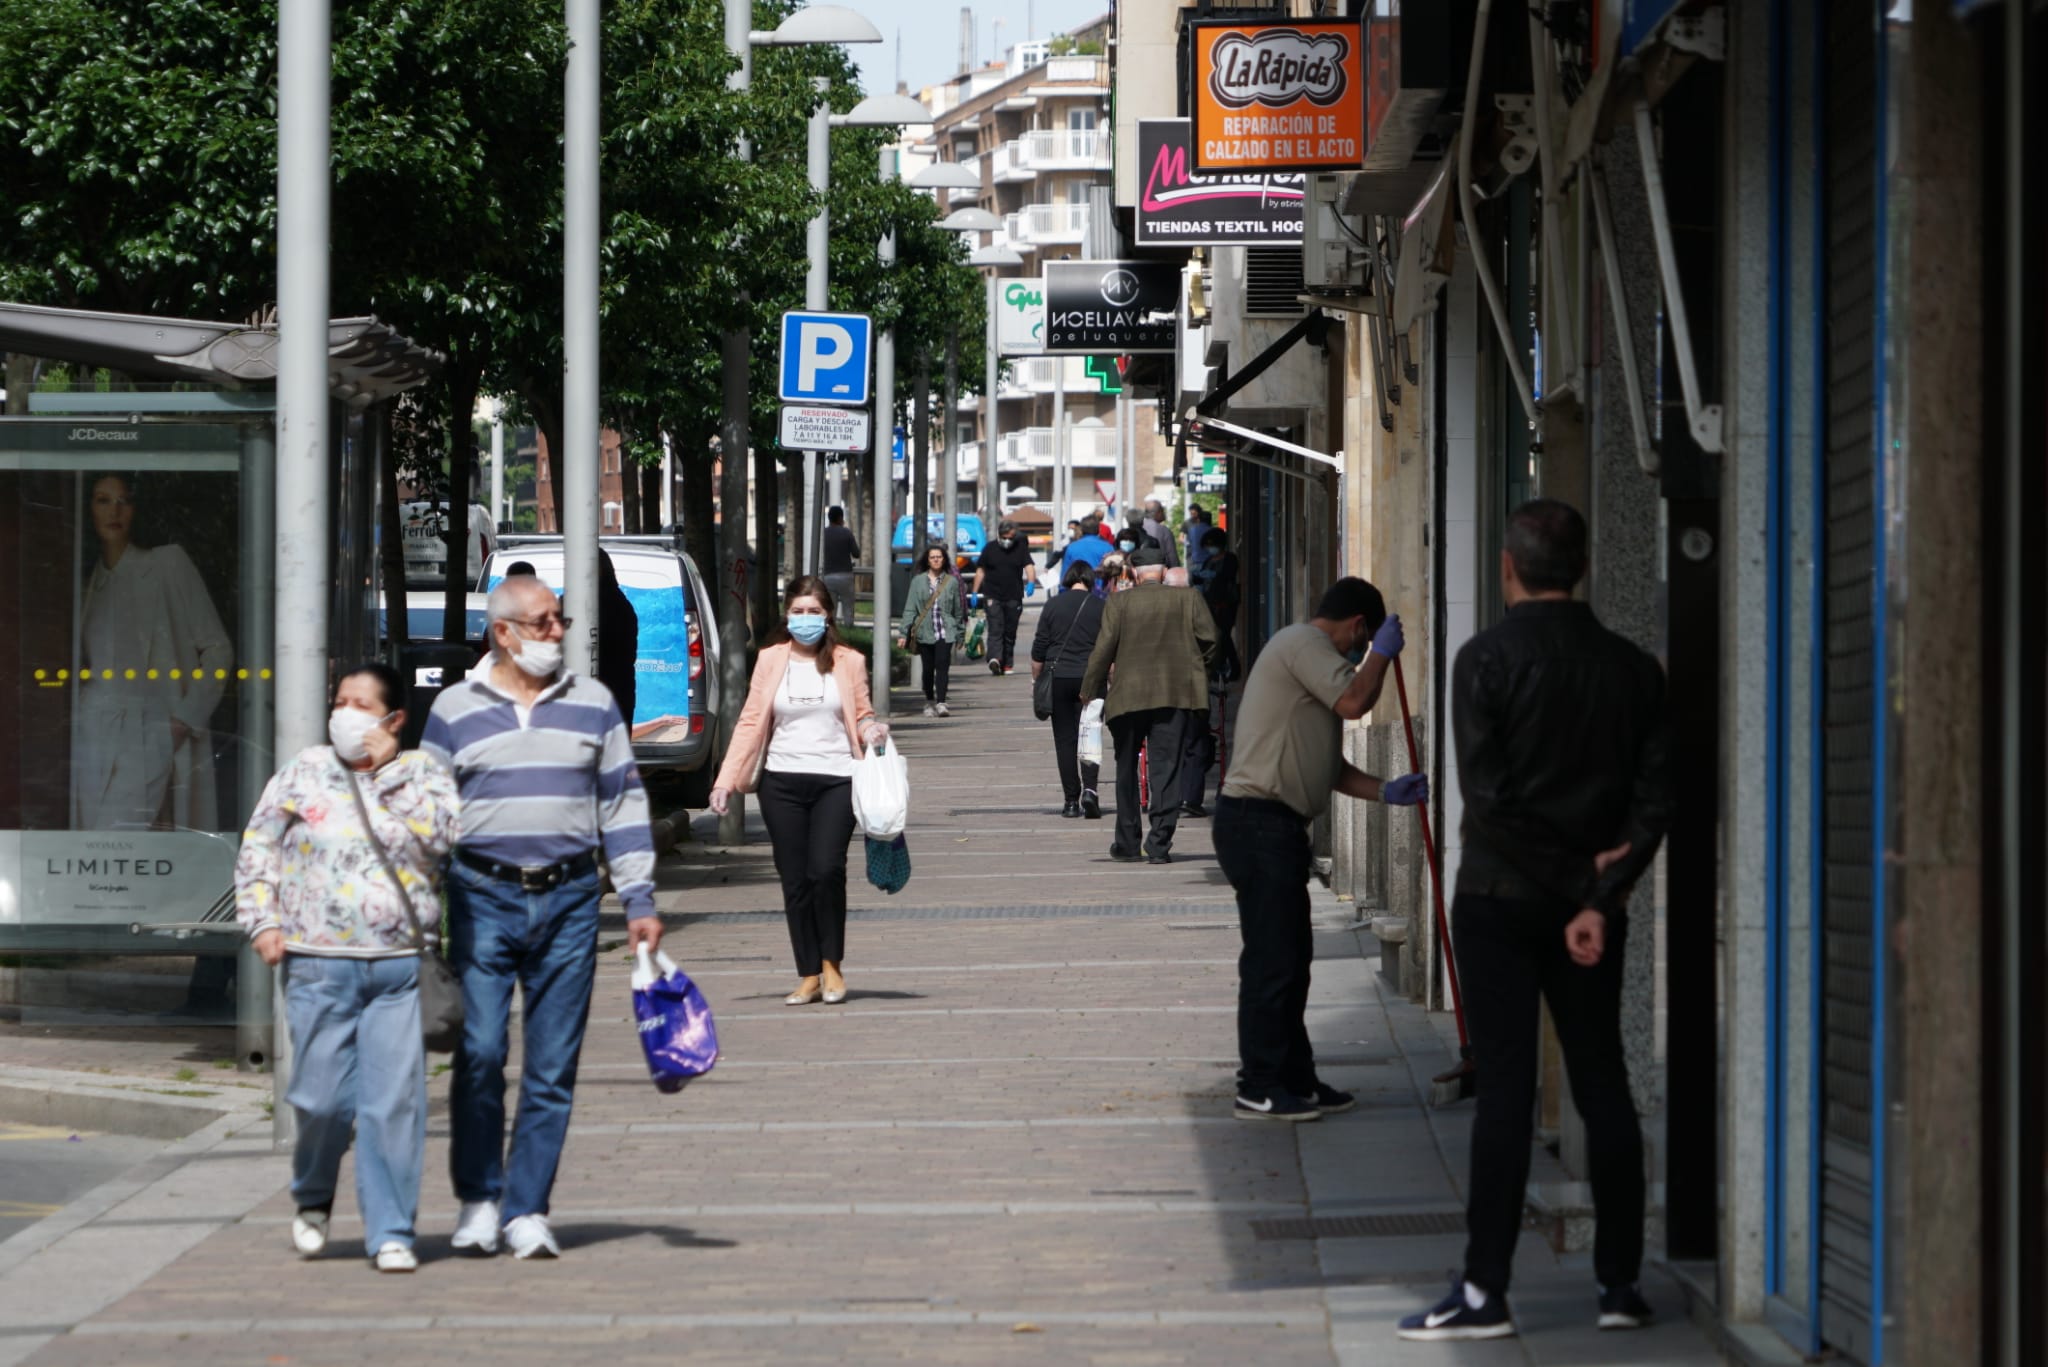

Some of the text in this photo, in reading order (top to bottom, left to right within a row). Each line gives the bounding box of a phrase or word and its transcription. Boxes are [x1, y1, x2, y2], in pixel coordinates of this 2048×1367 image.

[1224, 47, 1333, 91] La Rápida
[1223, 112, 1337, 136] REPARACIÓN DE
[1205, 139, 1355, 160] CALZADO EN EL ACTO
[1146, 221, 1211, 233] TIENDAS
[1215, 221, 1269, 233] TEXTIL
[798, 321, 854, 392] P
[801, 409, 848, 417] RESERVADO
[794, 424, 843, 433] LABORABLES
[822, 418, 862, 426] DESCARGA
[68, 428, 138, 440] JCDecaux
[47, 858, 173, 876] LIMITED
